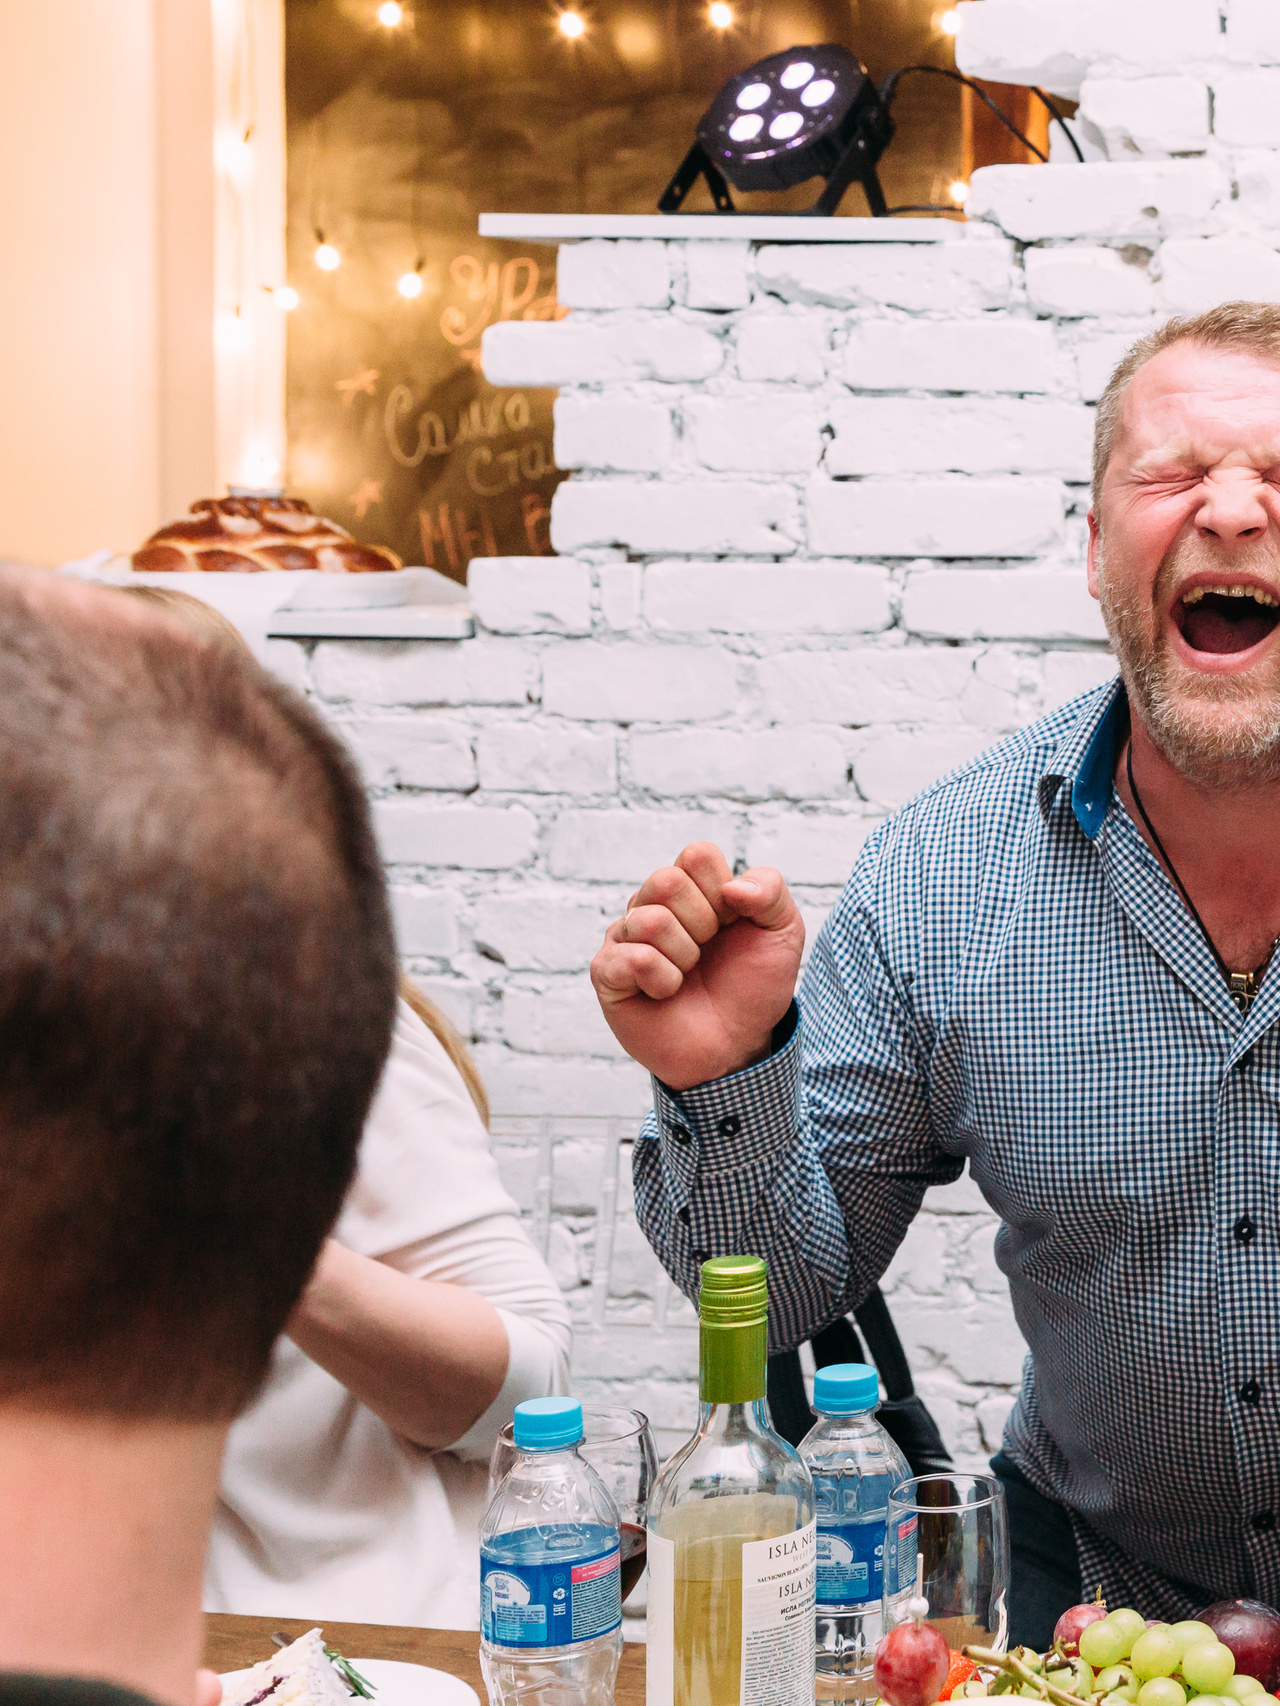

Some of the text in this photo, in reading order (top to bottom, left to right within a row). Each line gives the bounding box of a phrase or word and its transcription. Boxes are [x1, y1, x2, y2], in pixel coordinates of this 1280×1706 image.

[768, 1540, 798, 1560] ISLA
[778, 1580, 803, 1599] ISLA
[780, 1603, 798, 1615] ИСЛА
